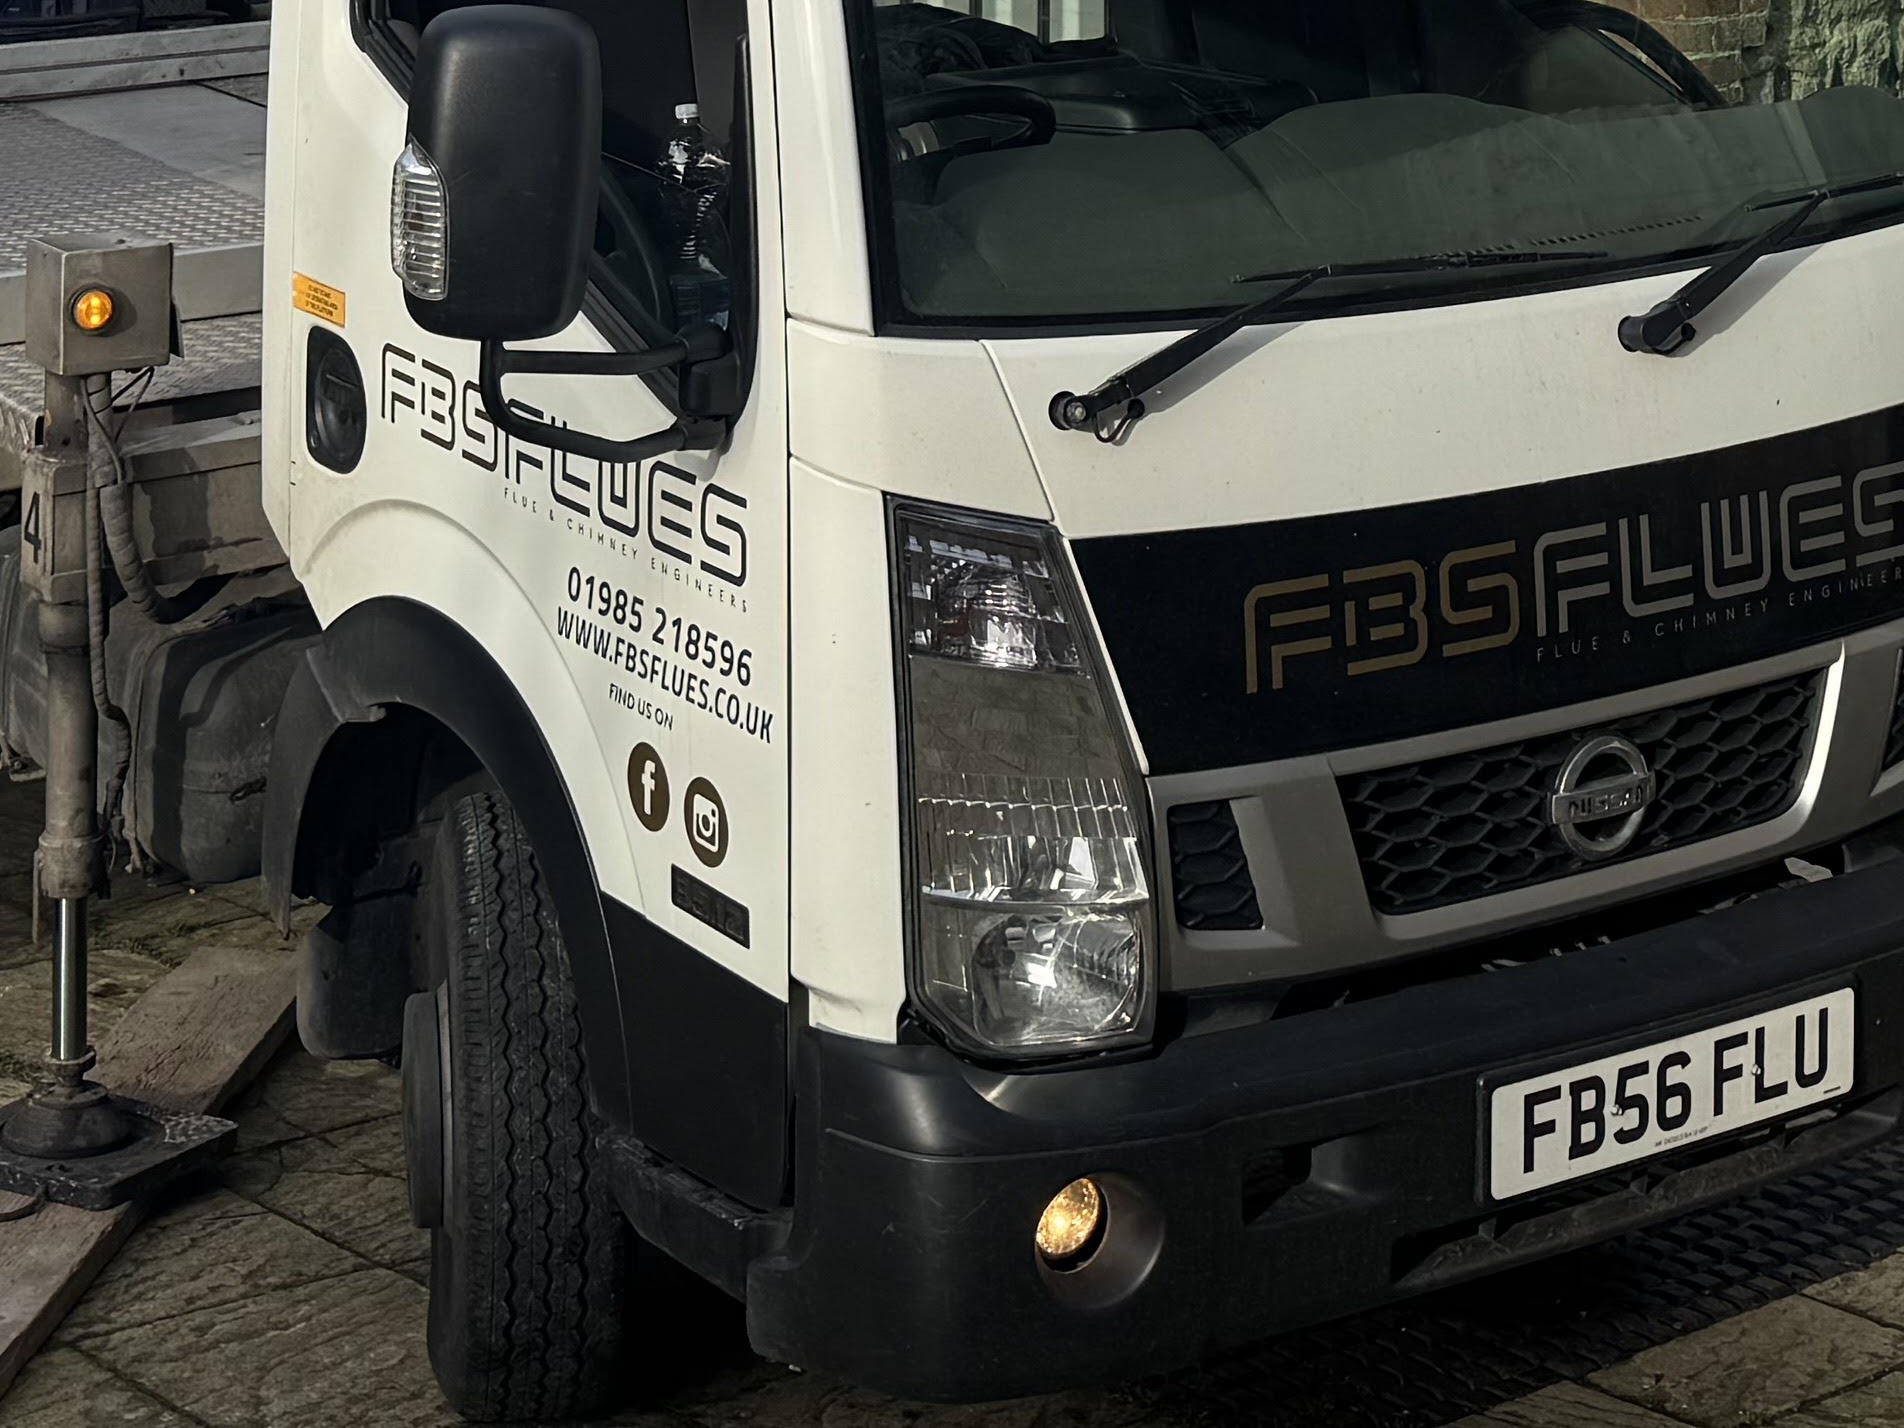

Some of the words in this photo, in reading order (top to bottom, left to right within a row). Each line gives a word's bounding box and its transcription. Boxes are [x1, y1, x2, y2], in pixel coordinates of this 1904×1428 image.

[23, 492, 43, 565] 4
[504, 487, 537, 513] FLUE
[566, 518, 638, 560] CHIMNEY
[651, 557, 748, 613] ENGINEERS
[556, 605, 775, 744] WWW.FBSFLUES.CO.UK
[567, 566, 645, 633] 01985
[653, 599, 753, 688] 218596
[1537, 636, 1600, 663] FLUE
[1655, 597, 1769, 637] CHIMNEY
[608, 681, 635, 712] FIND
[637, 695, 653, 722] US
[654, 707, 674, 731] ON
[1568, 781, 1652, 818] NISSAN
[1523, 1051, 1692, 1174] FB56
[1713, 1007, 1829, 1117] FLU
